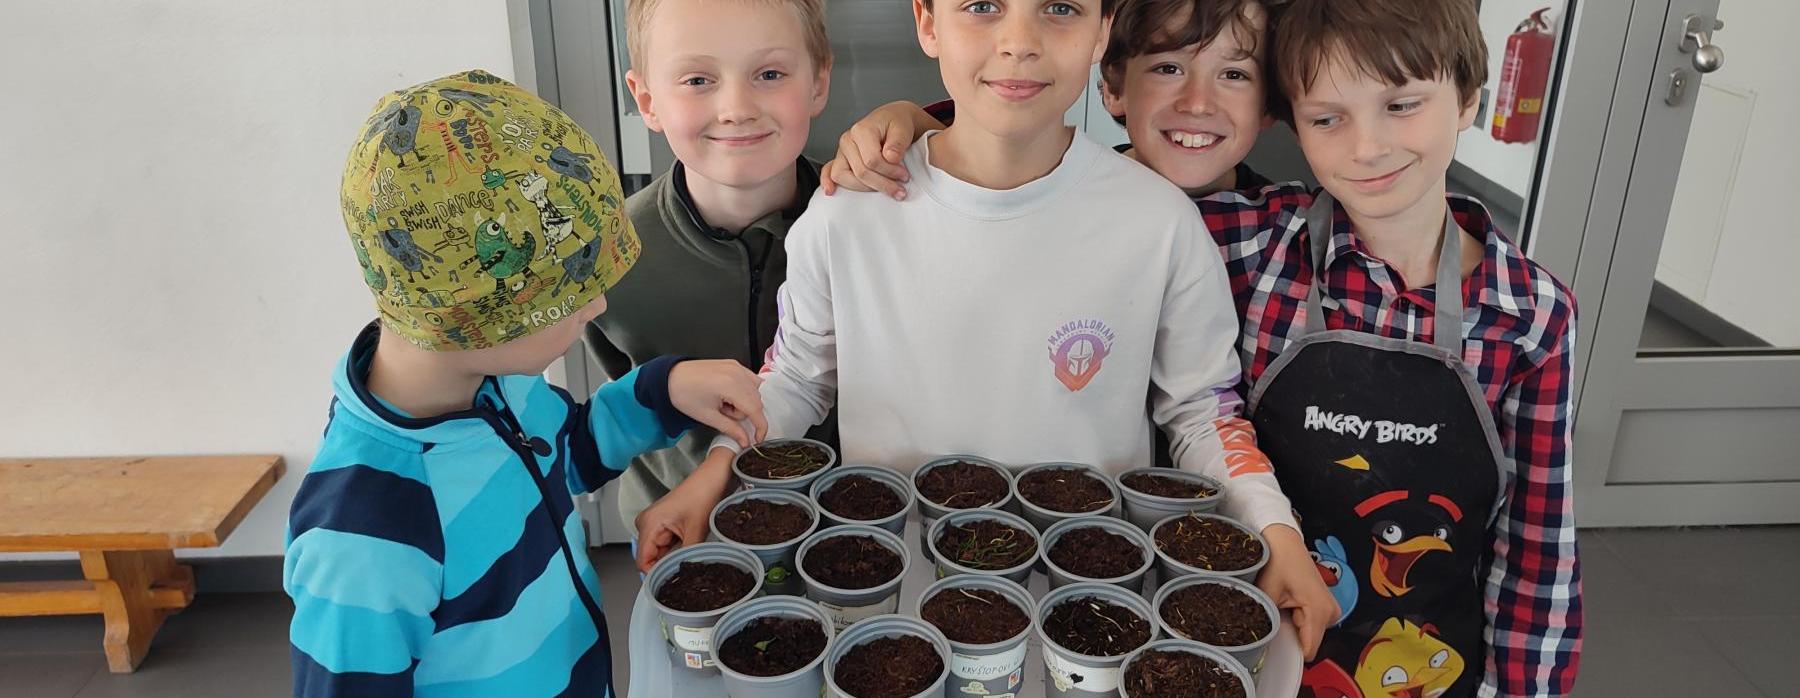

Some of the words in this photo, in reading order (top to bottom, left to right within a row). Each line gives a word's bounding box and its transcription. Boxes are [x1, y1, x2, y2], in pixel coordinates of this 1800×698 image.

[1047, 319, 1115, 345] MANDALORIAN
[1304, 405, 1372, 440] ANGRY
[1374, 420, 1438, 445] BIRDS
